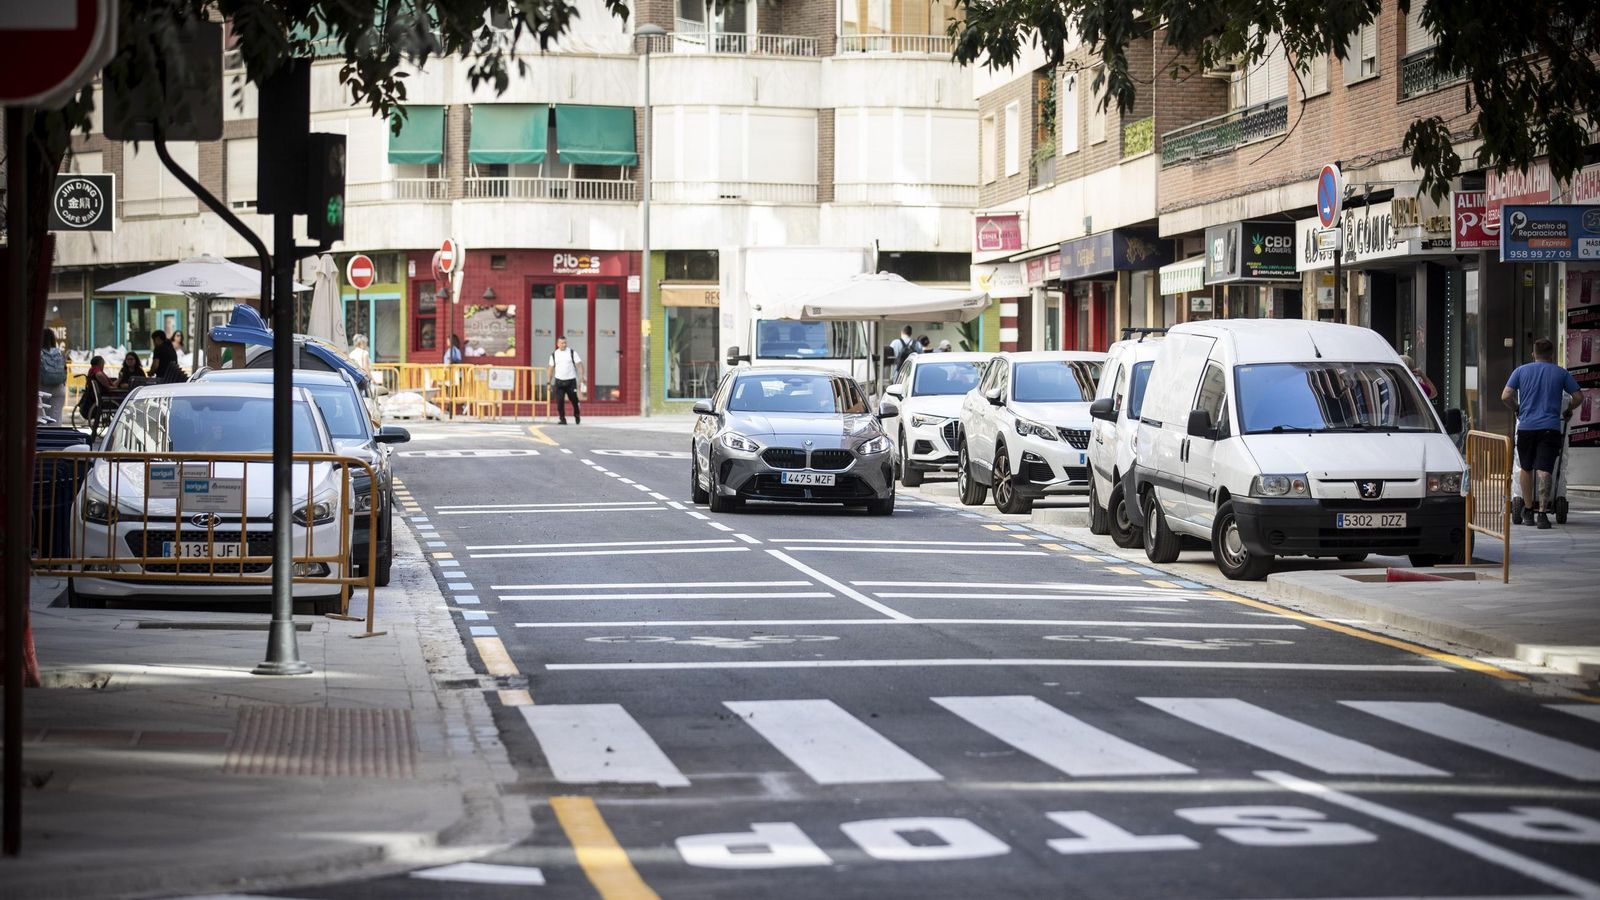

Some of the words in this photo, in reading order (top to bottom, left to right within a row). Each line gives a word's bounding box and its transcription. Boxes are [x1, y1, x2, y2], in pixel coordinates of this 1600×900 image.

[61, 183, 75, 197] JIN
[75, 182, 97, 198] DING
[81, 210, 97, 223] BAR
[1531, 222, 1556, 230] Centro
[1556, 222, 1567, 230] de
[1518, 229, 1567, 238] Reparaciones
[1264, 235, 1293, 248] CBD
[1541, 239, 1567, 248] Express
[1510, 250, 1528, 259] 958
[1530, 250, 1543, 259] 99
[1545, 250, 1557, 258] 27
[1558, 250, 1572, 258] 09
[788, 474, 812, 484] 4475
[814, 475, 833, 485] MZF
[1344, 514, 1373, 527] 5302
[1381, 514, 1402, 527] DZZ
[675, 804, 1379, 870] STOP
